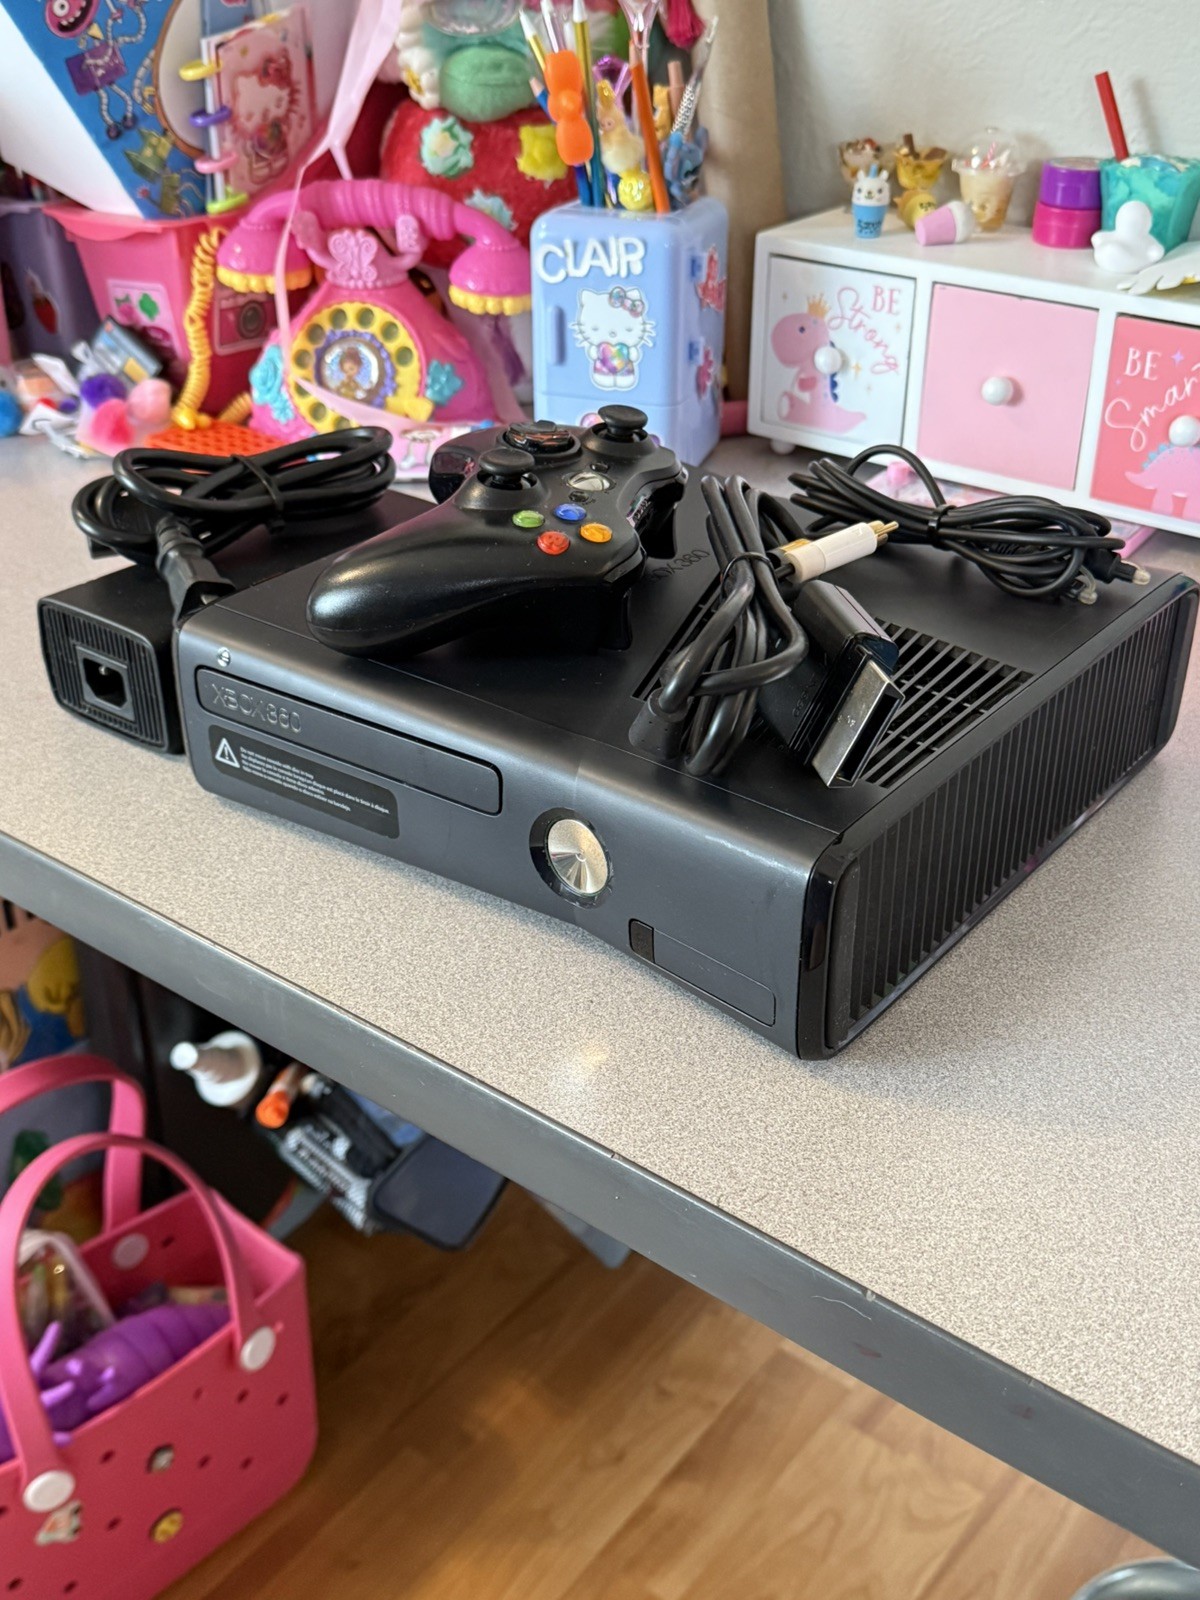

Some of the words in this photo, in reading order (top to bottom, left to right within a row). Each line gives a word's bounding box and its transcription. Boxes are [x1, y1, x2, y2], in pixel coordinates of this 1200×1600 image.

[536, 235, 647, 285] CLAIR
[872, 284, 902, 316] BE
[827, 286, 900, 375] Strong
[1125, 346, 1162, 382] BE
[1104, 362, 1200, 453] Smar
